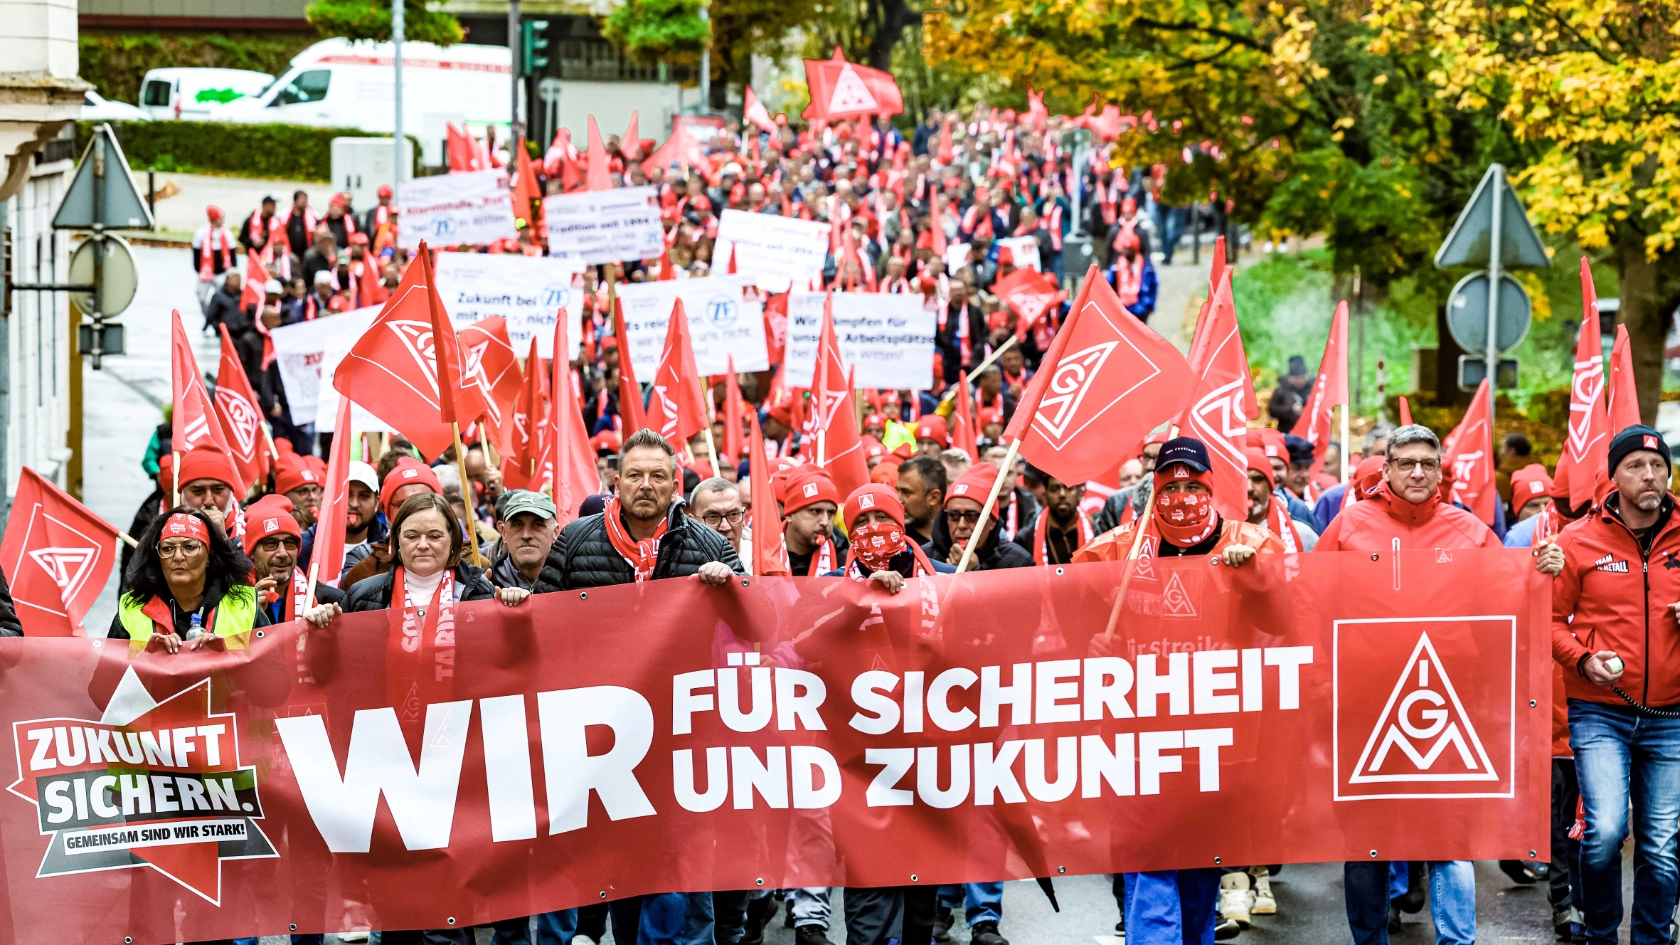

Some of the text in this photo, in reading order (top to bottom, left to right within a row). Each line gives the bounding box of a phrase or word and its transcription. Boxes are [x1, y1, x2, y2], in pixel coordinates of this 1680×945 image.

[457, 292, 511, 306] Zukunft
[516, 294, 538, 307] bei
[455, 310, 478, 321] mit
[527, 313, 557, 325] nich
[795, 316, 817, 326] Wir
[510, 330, 531, 341] ns!
[1595, 552, 1613, 566] TEAM
[1603, 560, 1629, 573] METALL
[673, 645, 1314, 736] FÜR SICHERHEIT
[27, 723, 226, 772] ZUKUNFT
[274, 686, 658, 853] WIR
[673, 727, 1234, 813] UND ZUKUNFT
[44, 774, 254, 824] SICHERN.
[66, 823, 245, 850] GEMEINSAM SIND WIR STARK!
